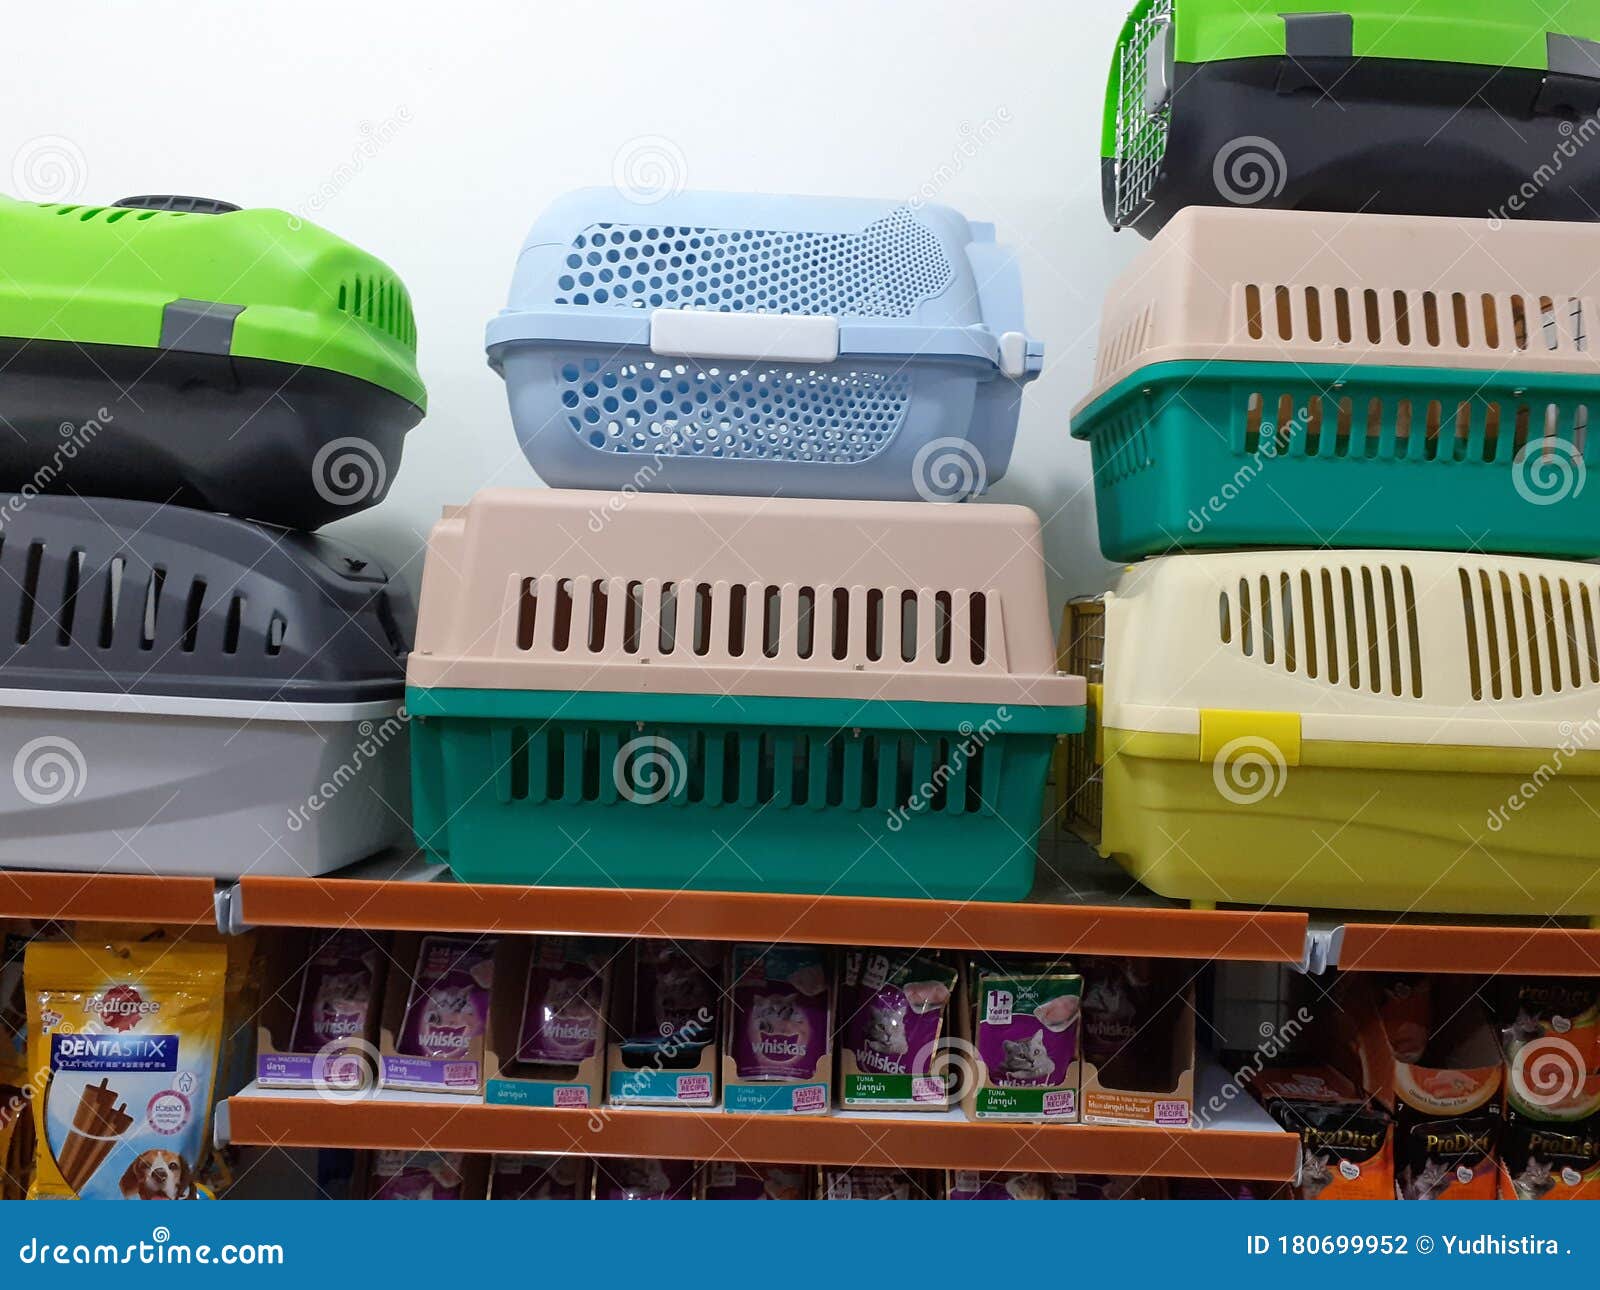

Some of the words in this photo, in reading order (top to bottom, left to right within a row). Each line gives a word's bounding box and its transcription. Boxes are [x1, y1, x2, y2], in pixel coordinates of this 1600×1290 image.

[990, 990, 1010, 1007] 1+
[83, 999, 160, 1015] Pedigree
[543, 1022, 599, 1039] whiskas
[1087, 1022, 1137, 1036] whiskas
[418, 1032, 470, 1047] whiskas
[60, 1039, 166, 1058] DENTASTIX
[752, 1039, 807, 1056] whiskas
[856, 1049, 907, 1074] whiskas
[680, 1077, 707, 1085] TASTIER
[556, 1088, 585, 1096] TASTIER
[795, 1088, 822, 1097] TASTIER
[797, 1094, 821, 1103] RECIPE
[1046, 1093, 1071, 1101] TASTIER
[1397, 1103, 1404, 1112] 7
[1509, 1111, 1516, 1120] 2
[1303, 1127, 1379, 1149] ProDiet
[1426, 1134, 1489, 1153] ProDiet
